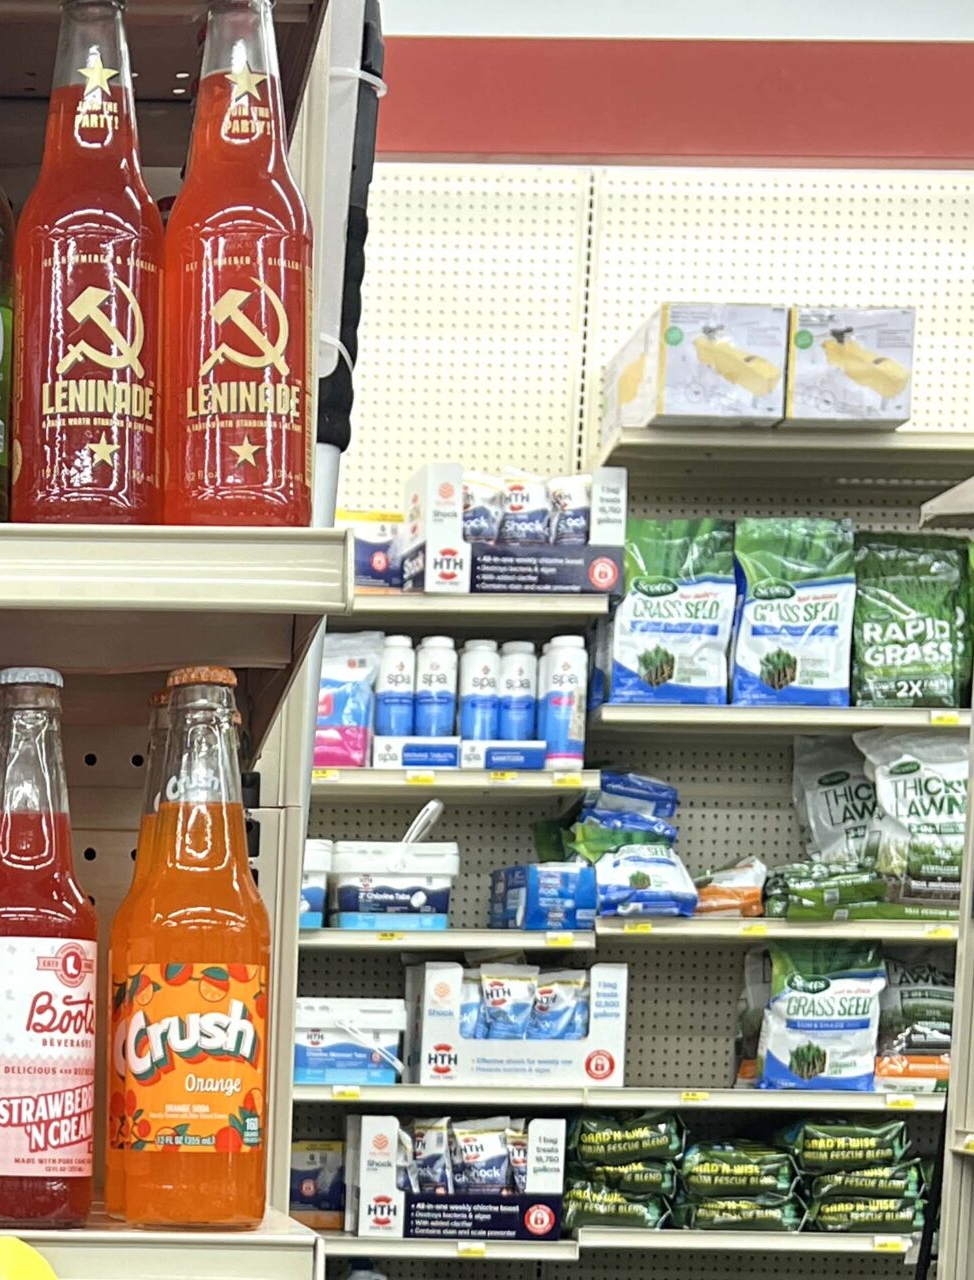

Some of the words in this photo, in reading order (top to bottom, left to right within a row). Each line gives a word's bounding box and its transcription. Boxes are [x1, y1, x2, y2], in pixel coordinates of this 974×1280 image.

[42, 379, 154, 420] LENINADE
[186, 380, 301, 418] LENINADE
[505, 518, 543, 532] Shock
[433, 558, 463, 571] HTH
[635, 578, 677, 594] Scotts
[863, 619, 950, 644] RAPID
[864, 641, 953, 666] GRASS
[422, 673, 447, 685] spa
[472, 677, 497, 689] spa
[552, 673, 578, 685] spa
[897, 681, 923, 698] 2X
[895, 795, 967, 818] LAWN
[486, 987, 511, 999] HTH
[786, 996, 834, 1016] GRASS
[839, 996, 874, 1016] SEED
[117, 999, 256, 1077] Crush
[428, 1053, 458, 1066] HTH
[5, 1066, 57, 1075] DELICIOUS
[185, 1074, 242, 1097] Orange
[459, 1143, 484, 1154] HTH
[367, 1159, 392, 1168] Shock
[367, 1204, 397, 1217] HTH
